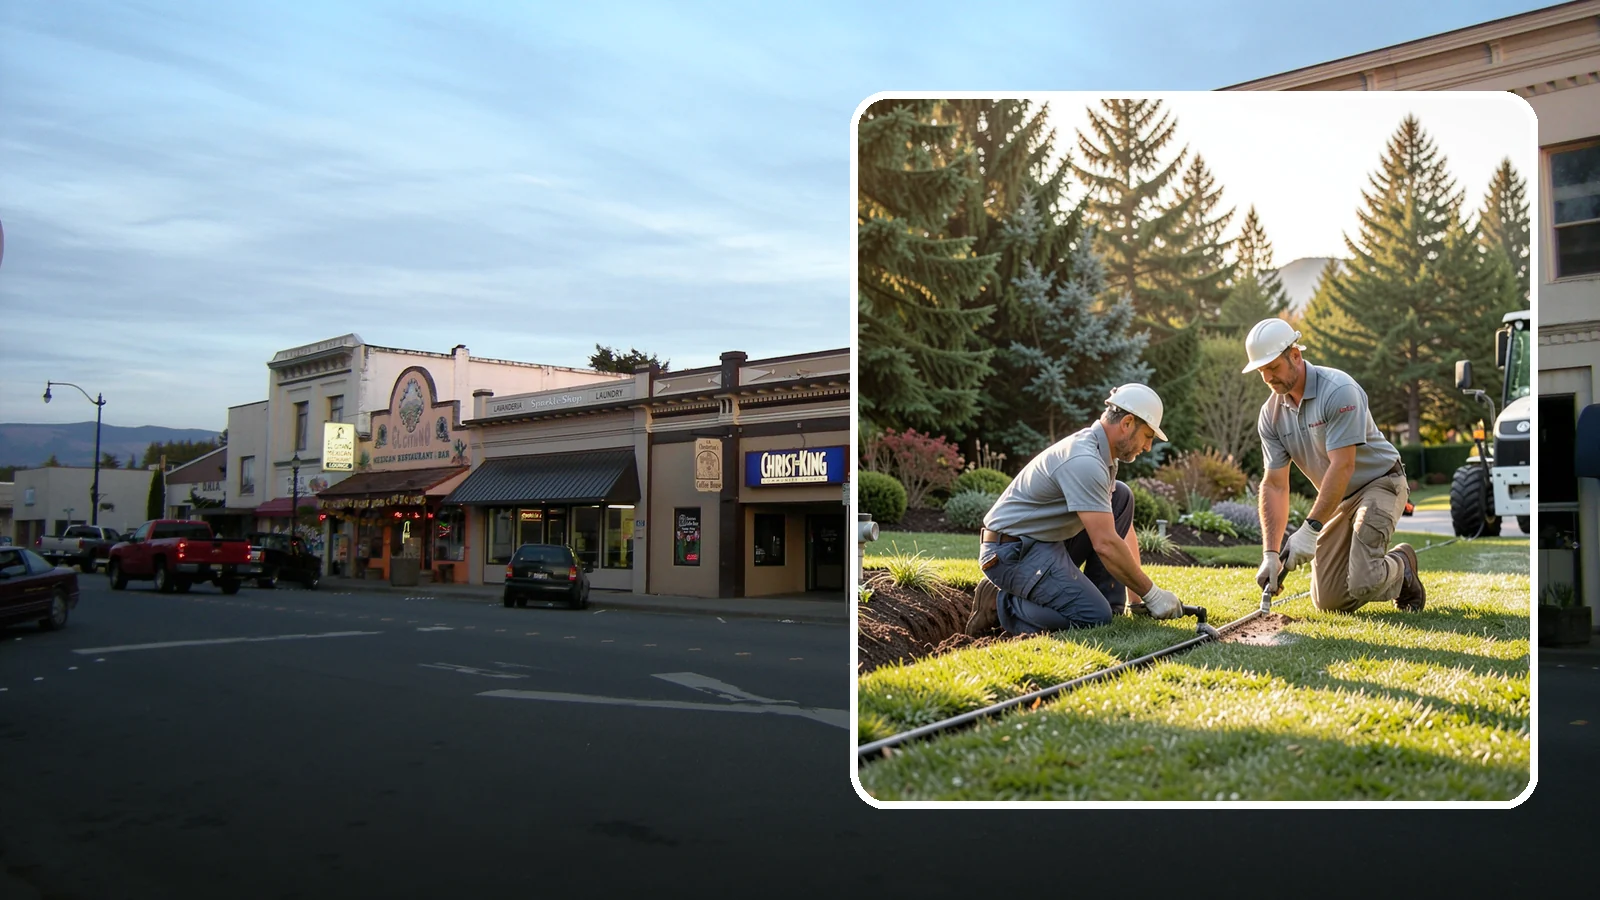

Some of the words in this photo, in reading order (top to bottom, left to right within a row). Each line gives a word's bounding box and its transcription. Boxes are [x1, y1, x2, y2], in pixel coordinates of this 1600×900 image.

[595, 389, 623, 400] LAUNDRY
[493, 402, 523, 412] LAVANDERIA
[531, 397, 561, 409] Sparkle
[562, 395, 582, 406] Shop
[373, 455, 396, 464] MEXICAN
[398, 451, 433, 462] RESTAURANT
[438, 450, 450, 459] BAR
[761, 452, 797, 478] CHRIST
[799, 450, 827, 476] KING
